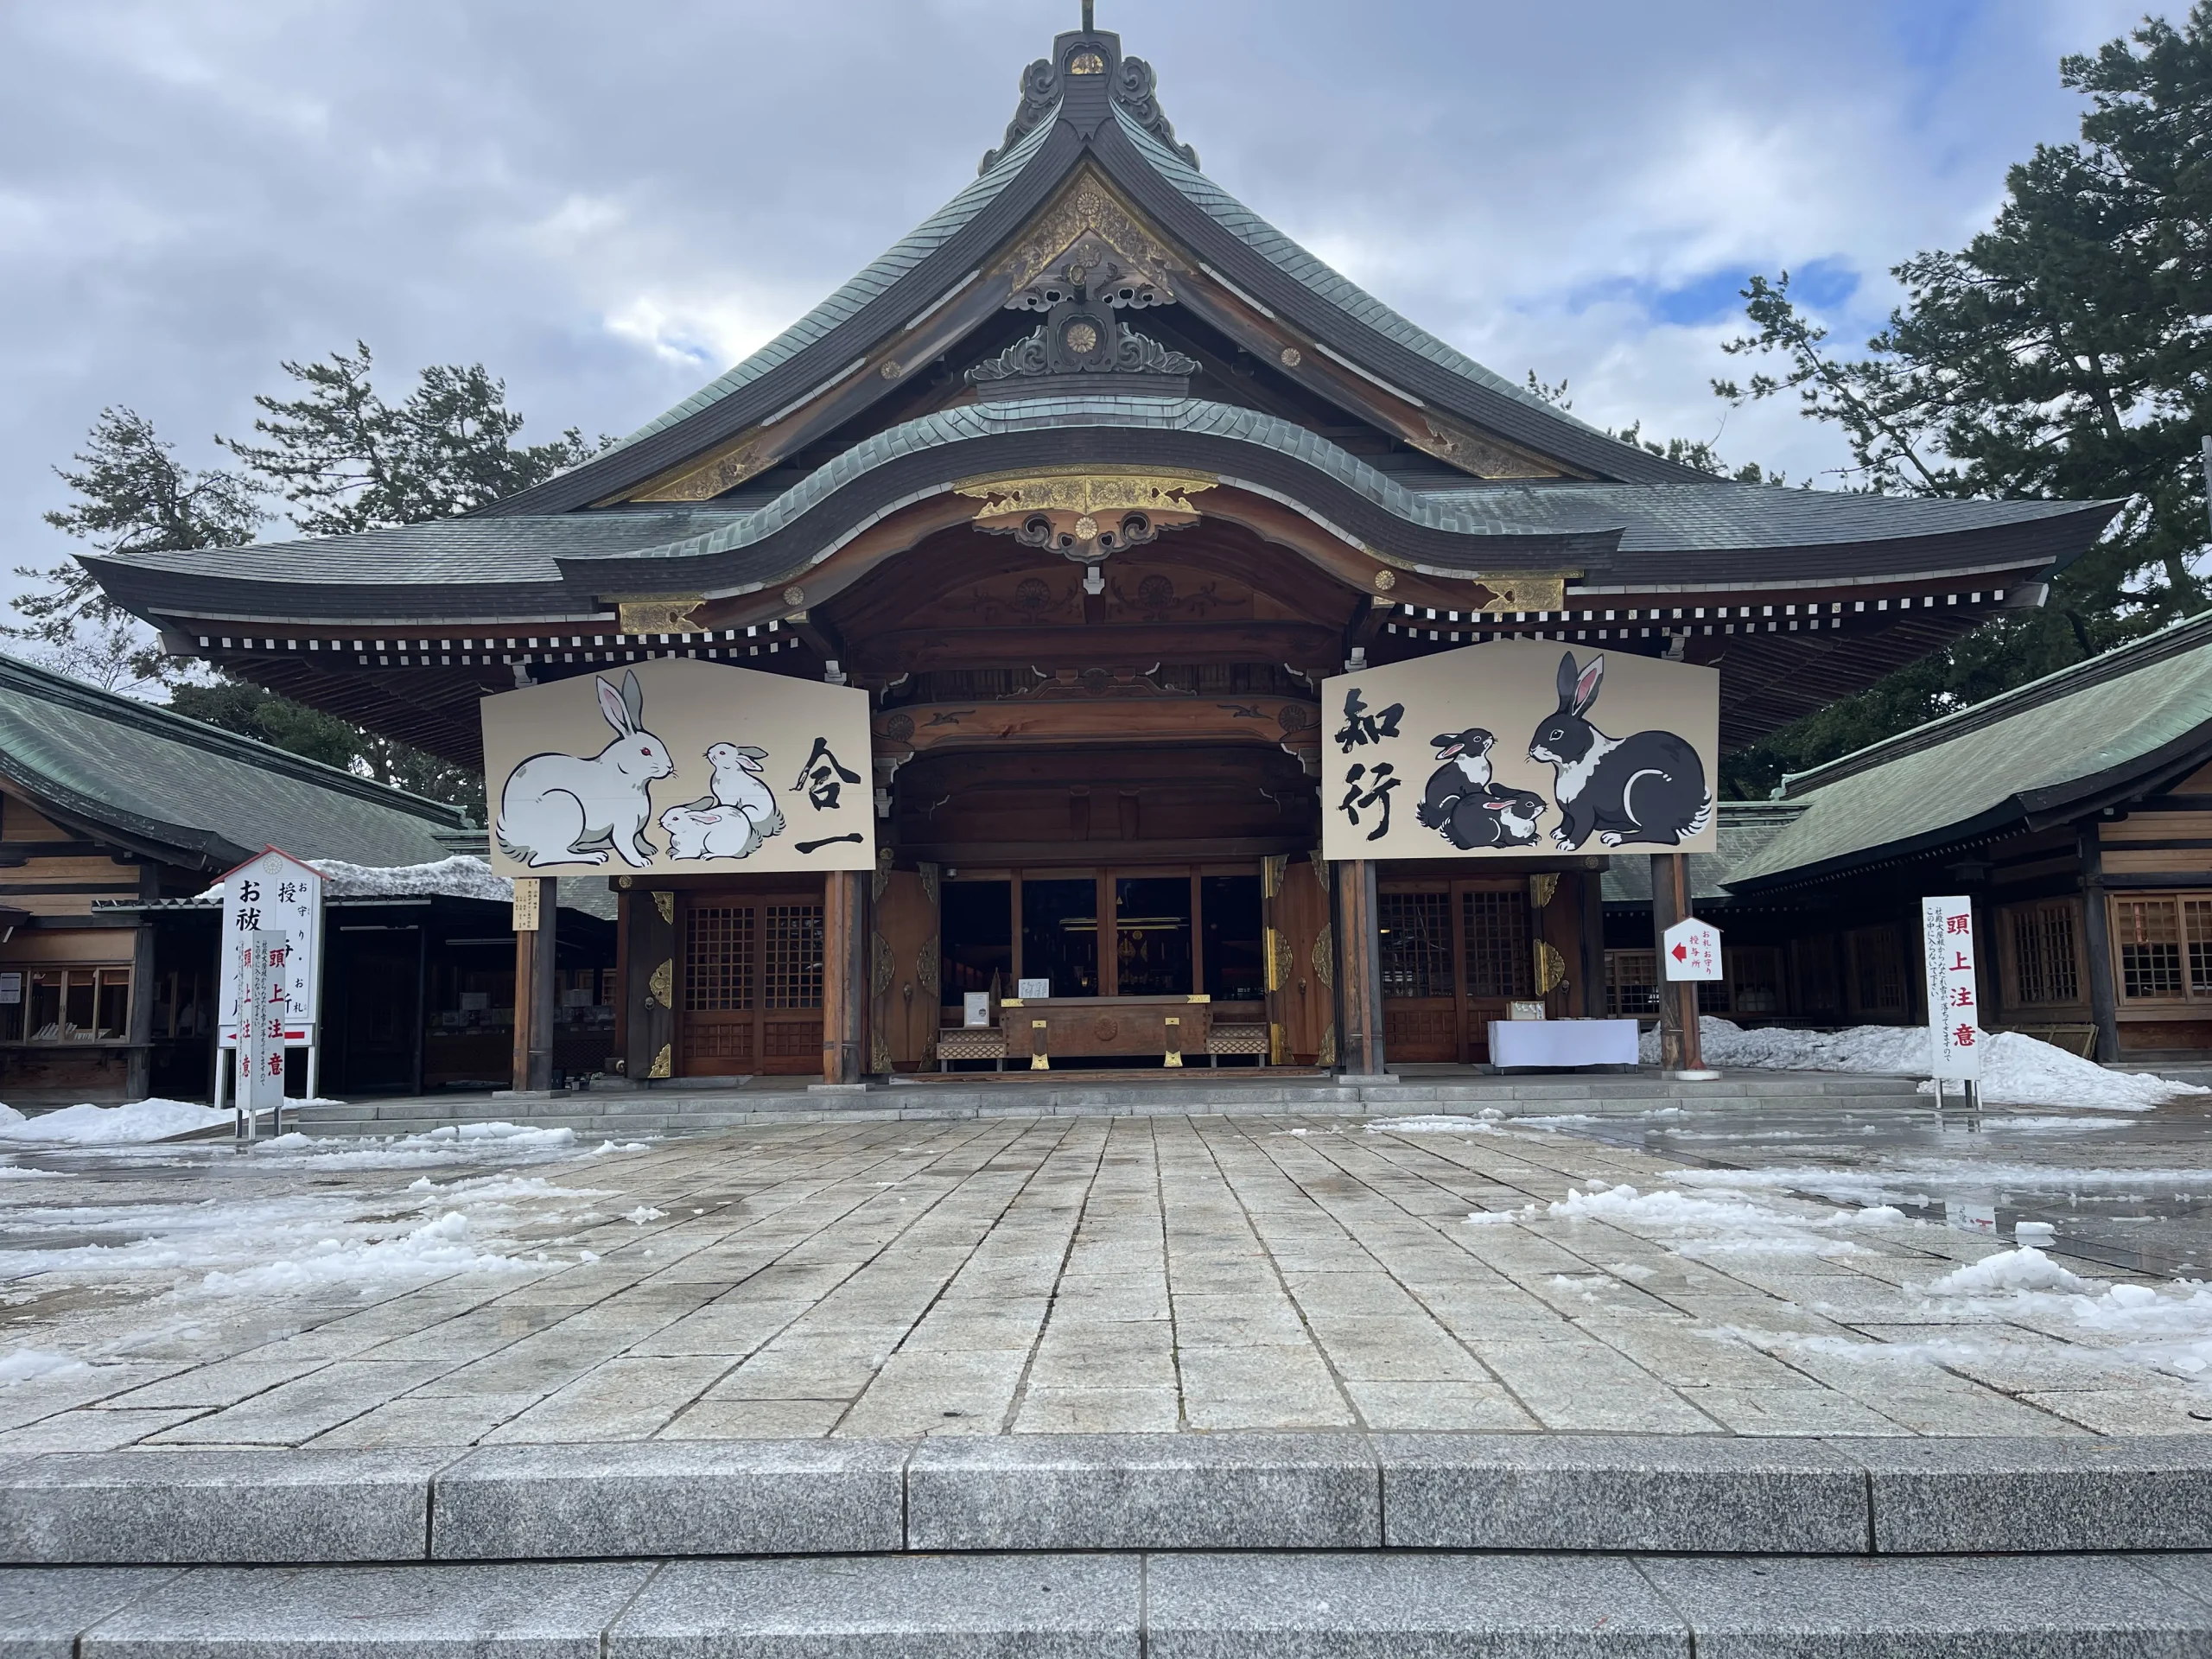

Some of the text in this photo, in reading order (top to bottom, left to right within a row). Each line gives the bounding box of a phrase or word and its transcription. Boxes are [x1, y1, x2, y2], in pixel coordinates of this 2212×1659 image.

[788, 736, 864, 855] 合一
[1334, 687, 1406, 842] 知行
[242, 947, 252, 1077] 頭上注意
[267, 948, 285, 1077] 頭上注意
[1689, 935, 1700, 969] 授与所
[1702, 931, 1713, 975] お札・お守り
[1946, 912, 1976, 1046] 頭上注意
